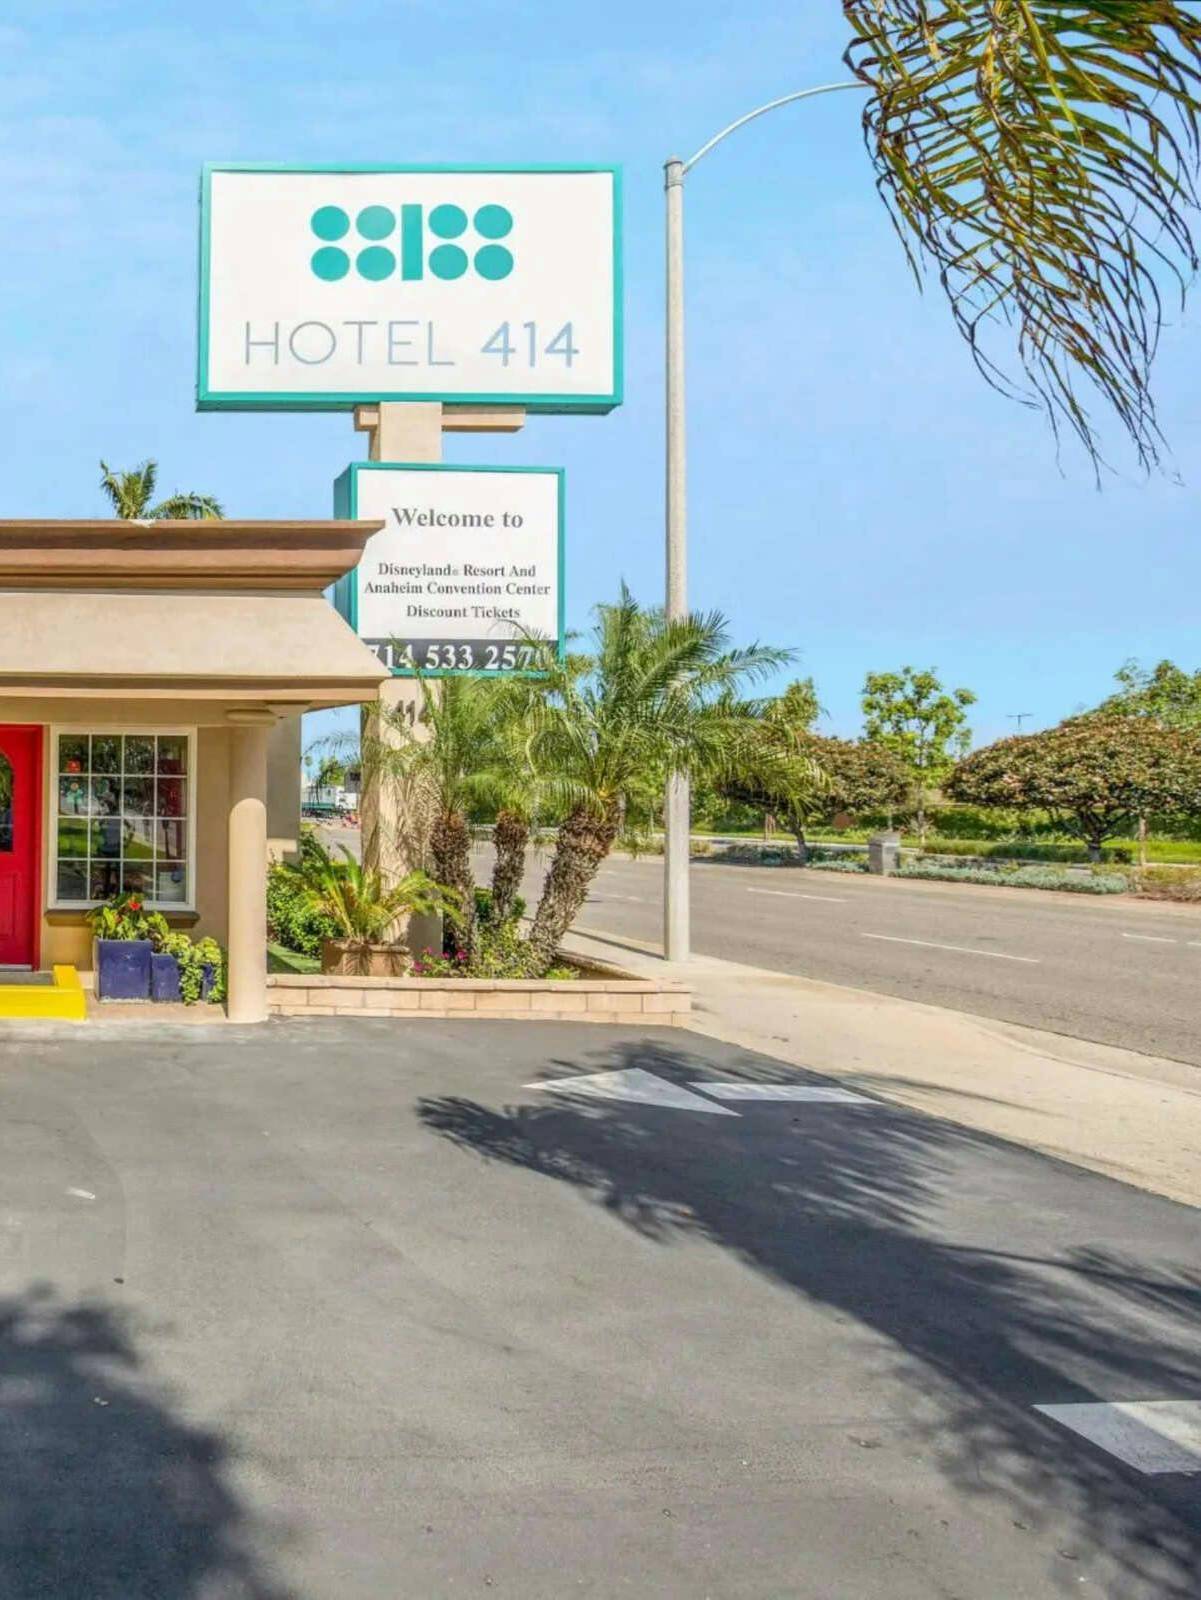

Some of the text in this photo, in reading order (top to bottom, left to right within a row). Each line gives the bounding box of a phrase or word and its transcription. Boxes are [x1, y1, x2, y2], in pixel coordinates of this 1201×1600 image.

[245, 321, 580, 369] HOTEL 414
[392, 508, 523, 528] Welcome to
[463, 565, 505, 577] Resort
[509, 565, 536, 577] And
[365, 582, 551, 595] Anaheim Convention Center
[406, 605, 521, 618] Discount Tickets
[425, 645, 473, 669] 533
